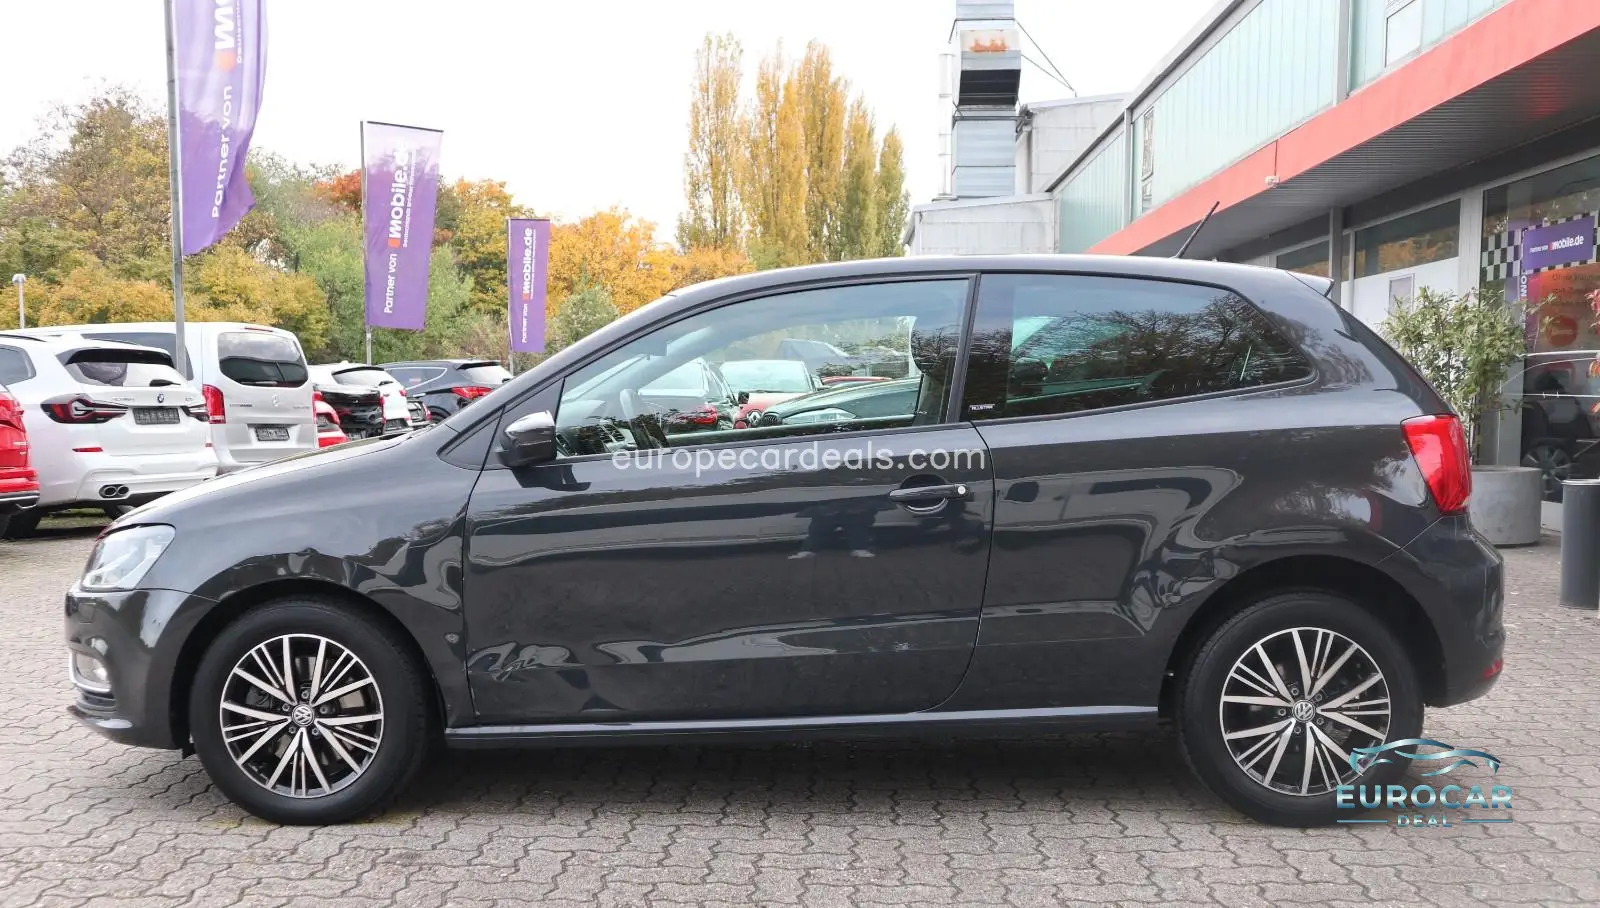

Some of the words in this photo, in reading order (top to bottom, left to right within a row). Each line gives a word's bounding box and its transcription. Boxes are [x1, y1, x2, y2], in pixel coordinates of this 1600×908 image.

[212, 135, 229, 217] Partner
[222, 86, 232, 130] von
[523, 228, 533, 293] mobile.de
[1551, 235, 1584, 250] mobile.de
[389, 253, 398, 276] von
[384, 276, 396, 313] Partner
